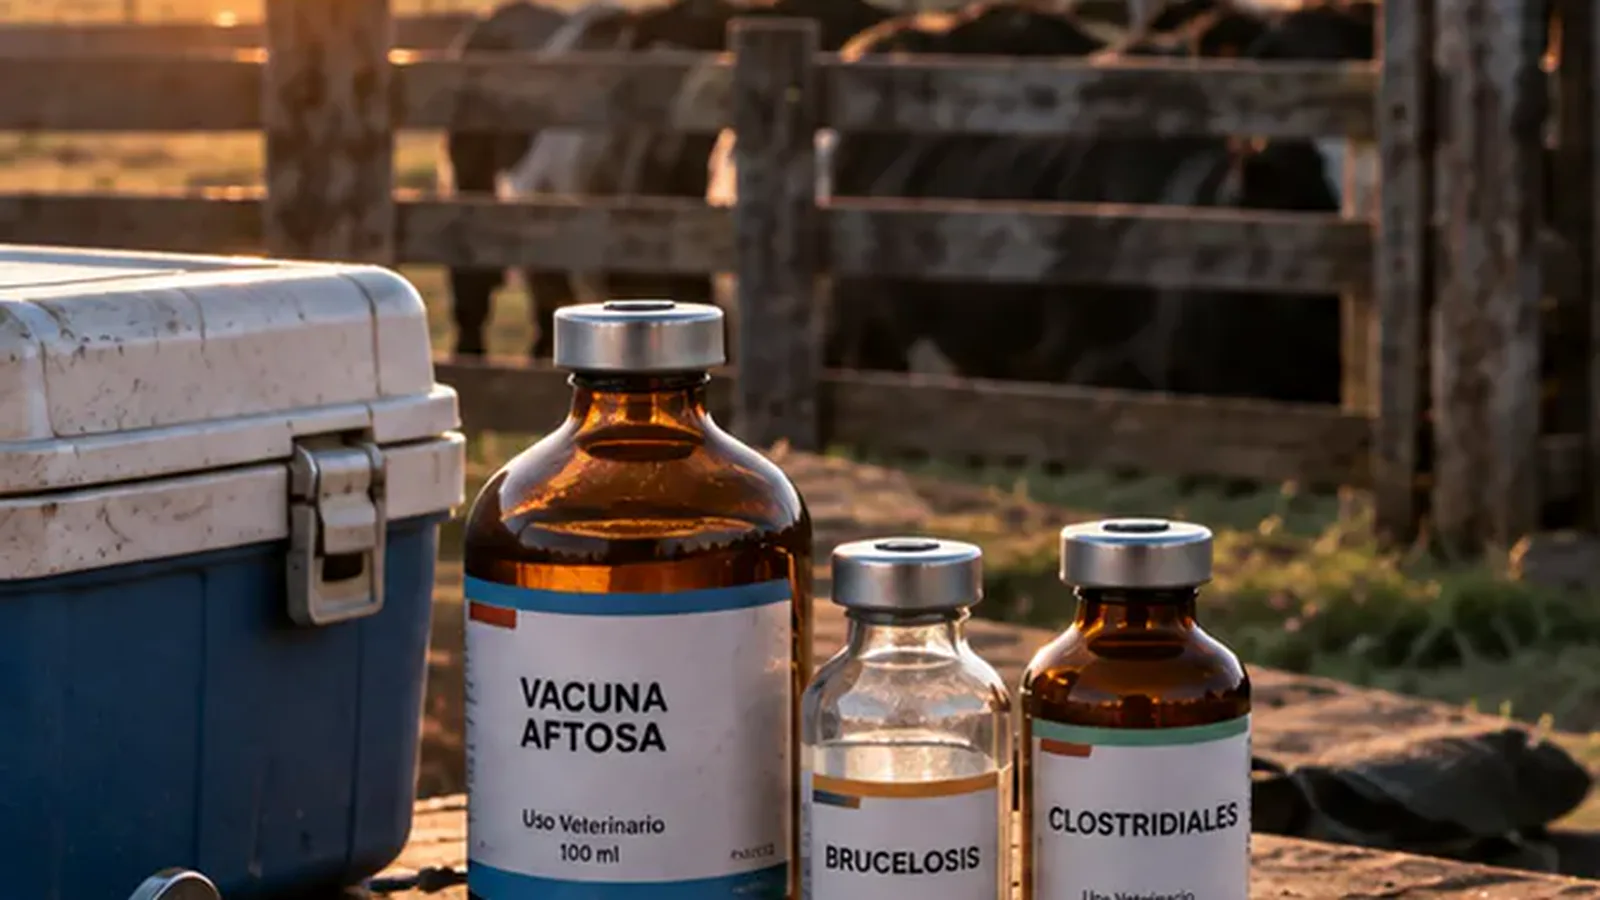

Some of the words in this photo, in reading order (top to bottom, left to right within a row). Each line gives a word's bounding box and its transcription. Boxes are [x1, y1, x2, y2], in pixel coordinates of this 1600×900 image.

[520, 676, 668, 713] VACUNA
[520, 718, 666, 753] AFTOSA
[522, 808, 555, 831] Uso
[559, 814, 665, 834] Veterinario
[1048, 802, 1238, 837] CLOSTRIDIALES
[560, 843, 591, 862] 100
[596, 845, 619, 863] ml
[824, 845, 980, 875] BRUCELOSIS
